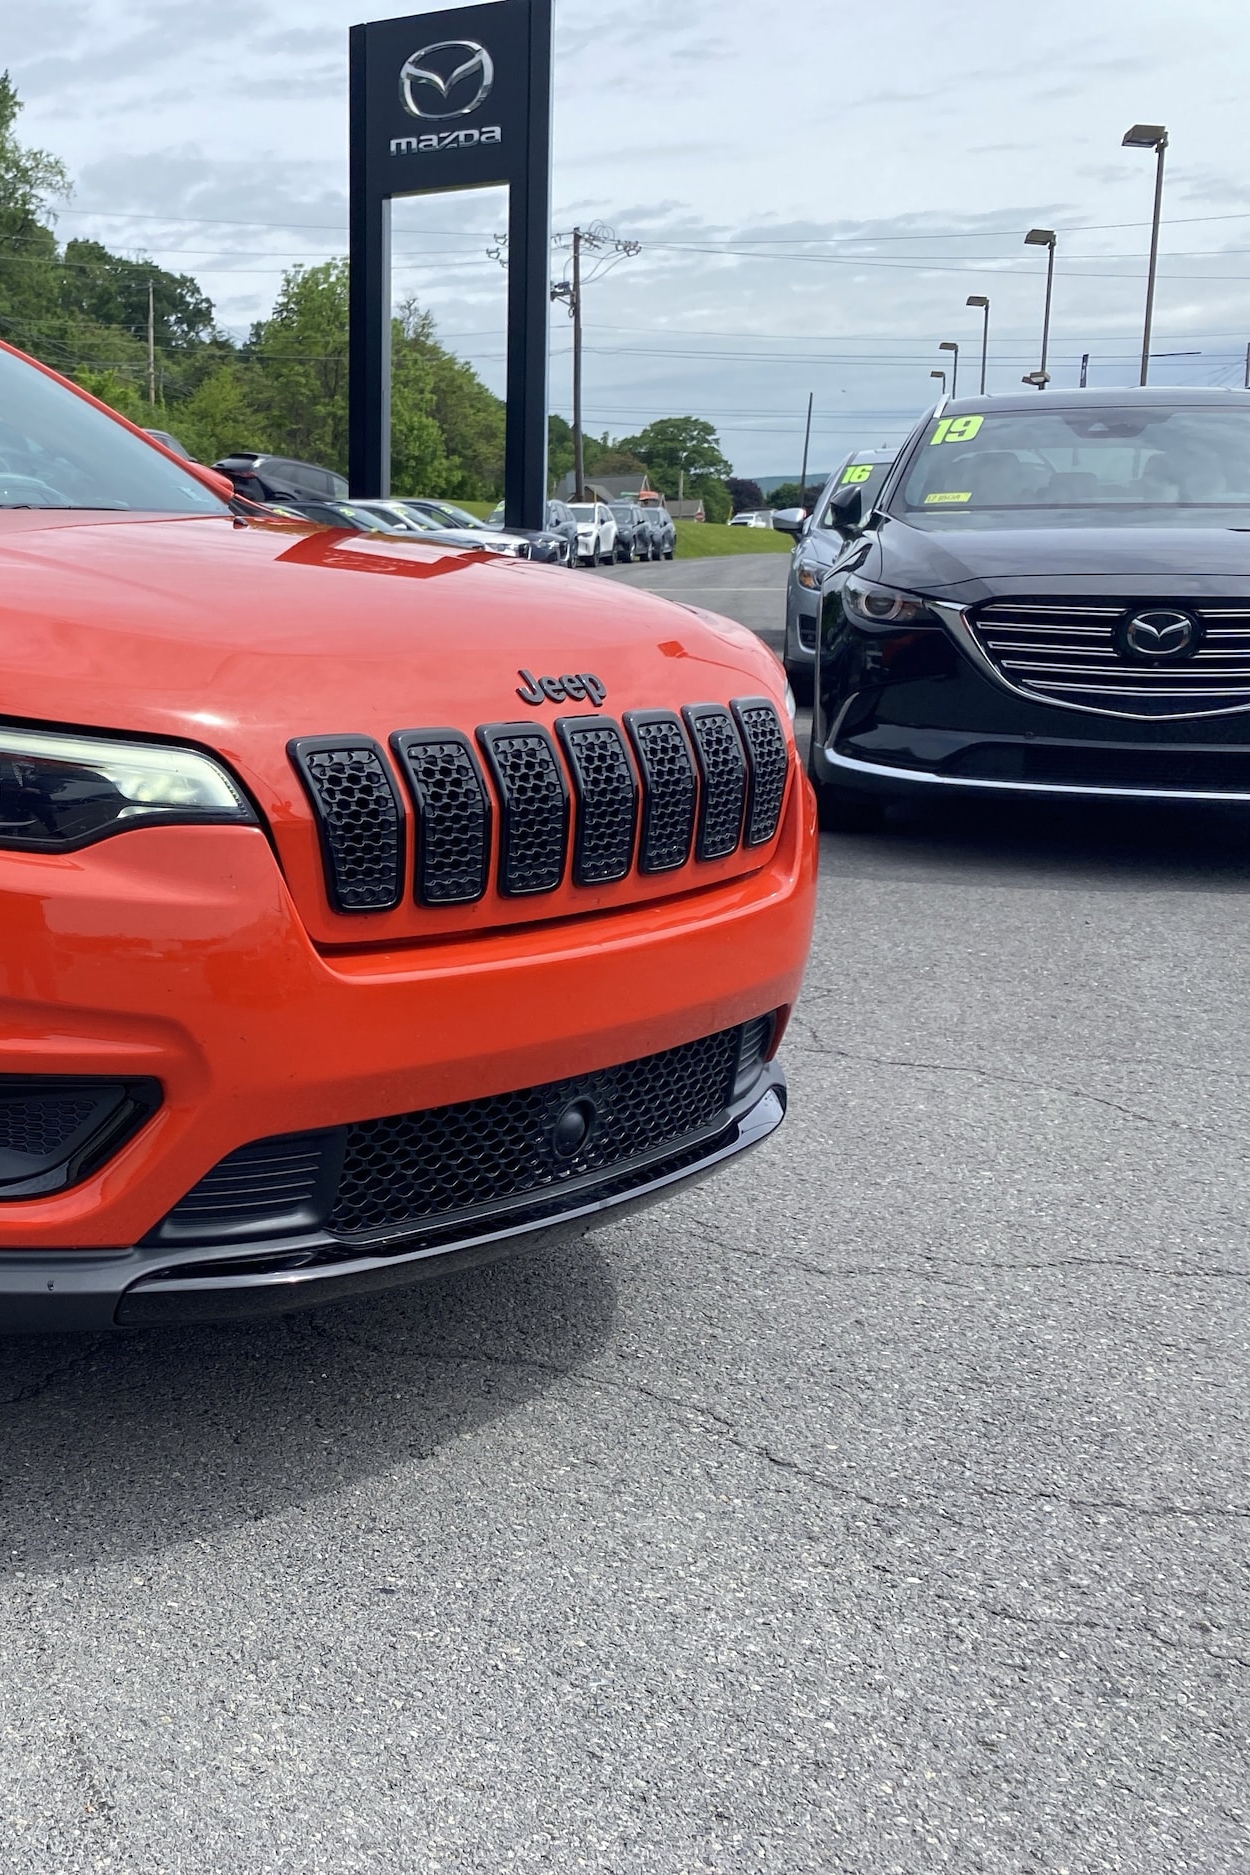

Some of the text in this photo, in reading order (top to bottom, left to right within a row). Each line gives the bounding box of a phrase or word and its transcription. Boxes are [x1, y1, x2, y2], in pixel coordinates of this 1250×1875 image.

[930, 415, 984, 445] 19
[841, 464, 874, 484] 16
[516, 669, 607, 707] Jeep
